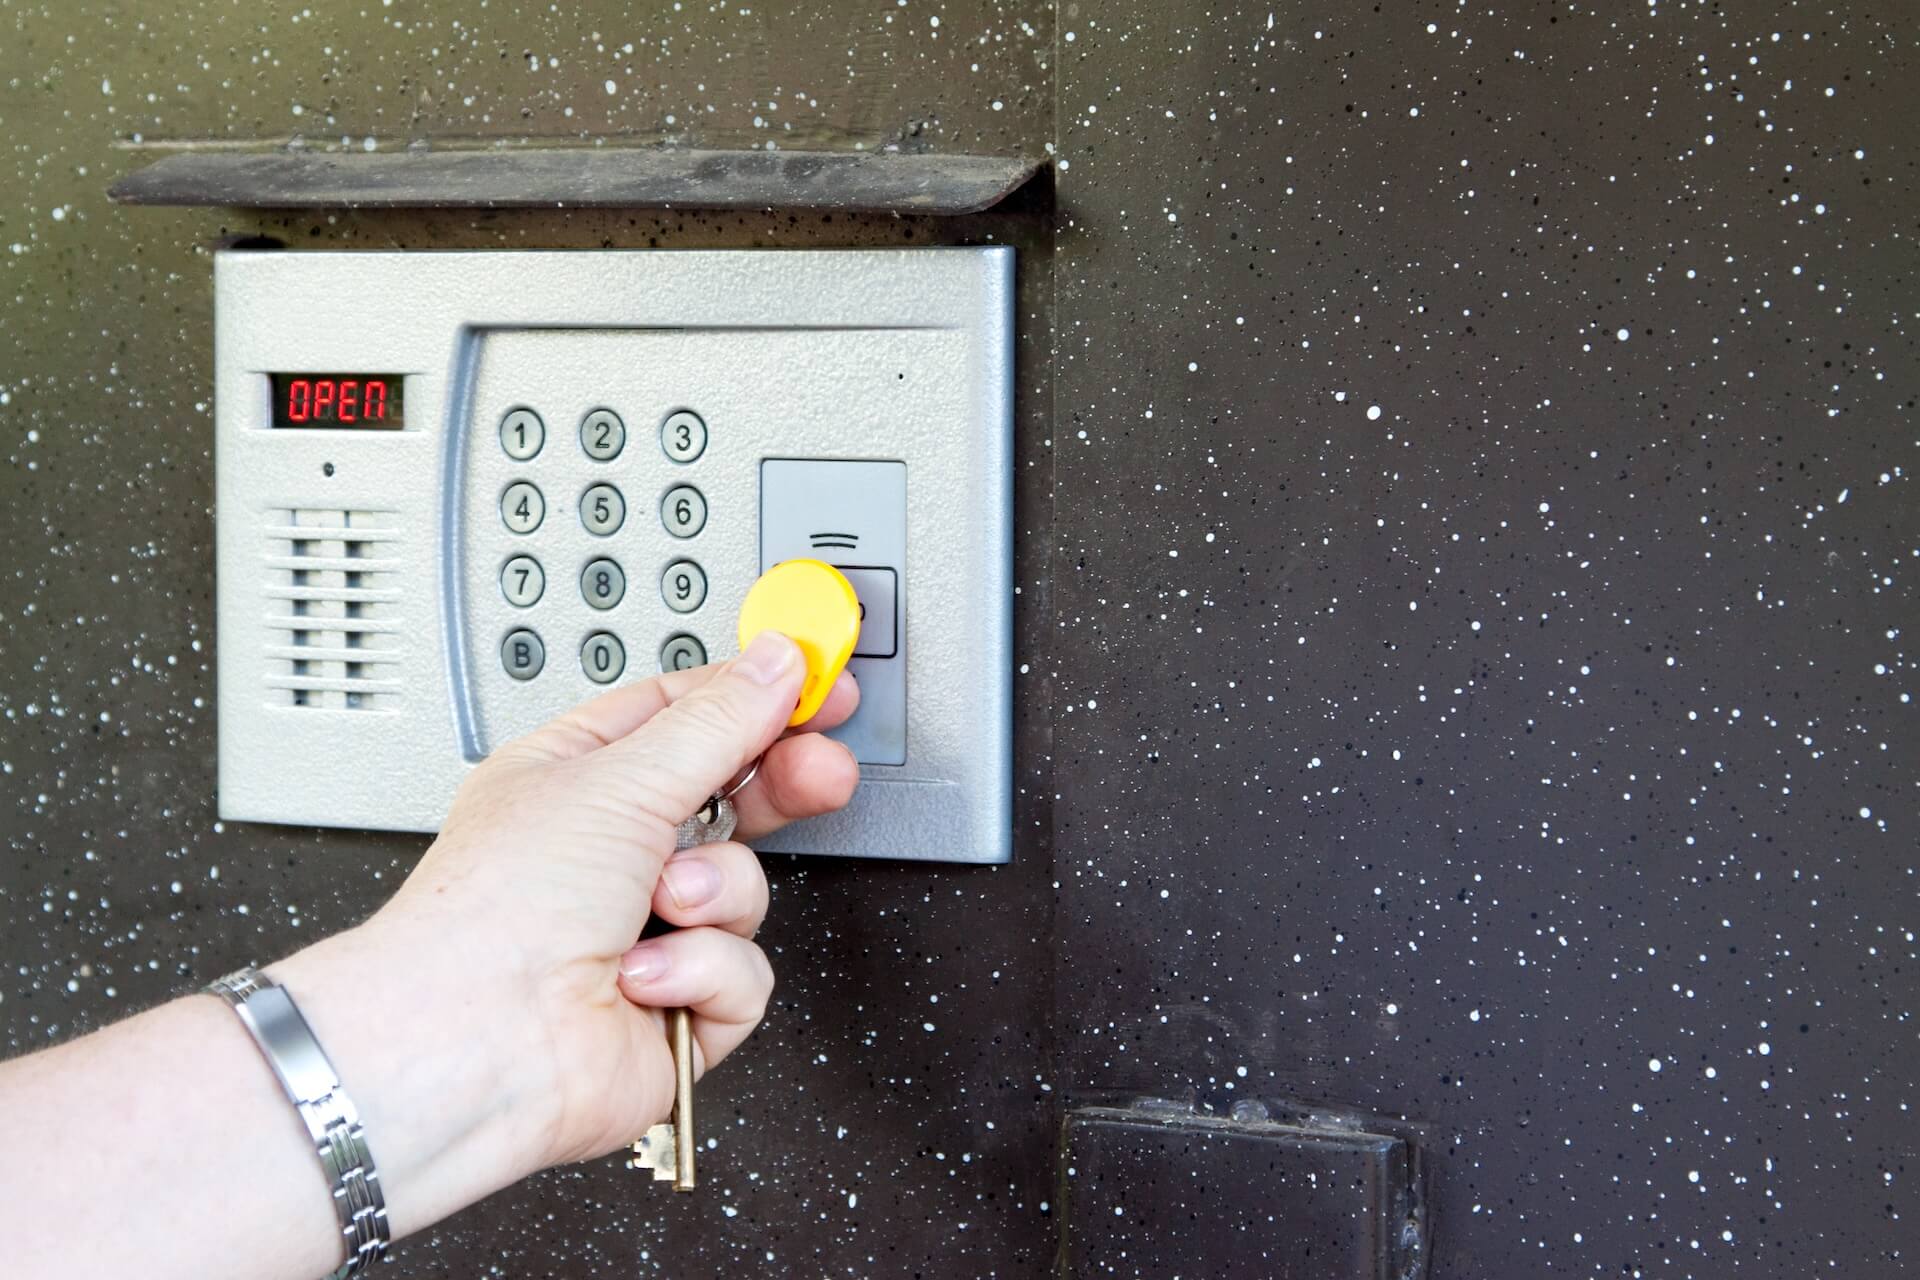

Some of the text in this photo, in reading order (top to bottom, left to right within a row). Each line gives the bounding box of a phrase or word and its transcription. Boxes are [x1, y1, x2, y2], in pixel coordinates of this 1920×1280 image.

[514, 422, 525, 448] 1
[594, 422, 610, 449] 2
[675, 425, 691, 451] 3
[514, 496, 530, 523] 4
[594, 497, 610, 524] 5
[675, 499, 691, 525] 6
[514, 569, 530, 595] 7
[595, 572, 611, 598] 8
[675, 574, 691, 600] 9
[514, 643, 531, 668] B
[673, 649, 692, 671] C
